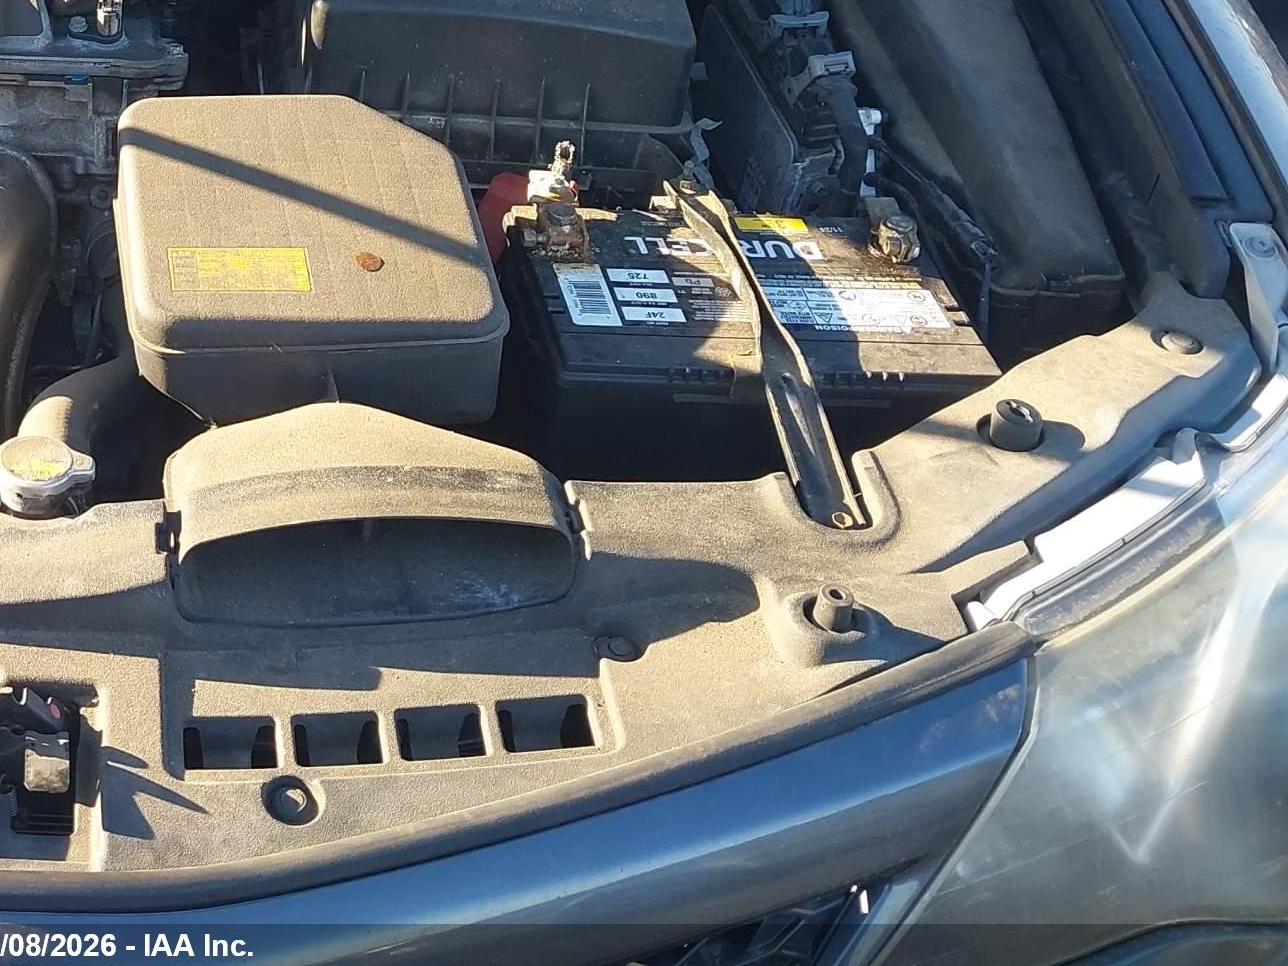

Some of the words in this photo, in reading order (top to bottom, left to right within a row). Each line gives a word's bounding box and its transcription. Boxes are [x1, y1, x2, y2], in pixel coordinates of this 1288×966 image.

[623, 235, 825, 261] DURCELL
[627, 272, 650, 281] 725
[635, 290, 657, 300] 890
[645, 310, 666, 320] 24F
